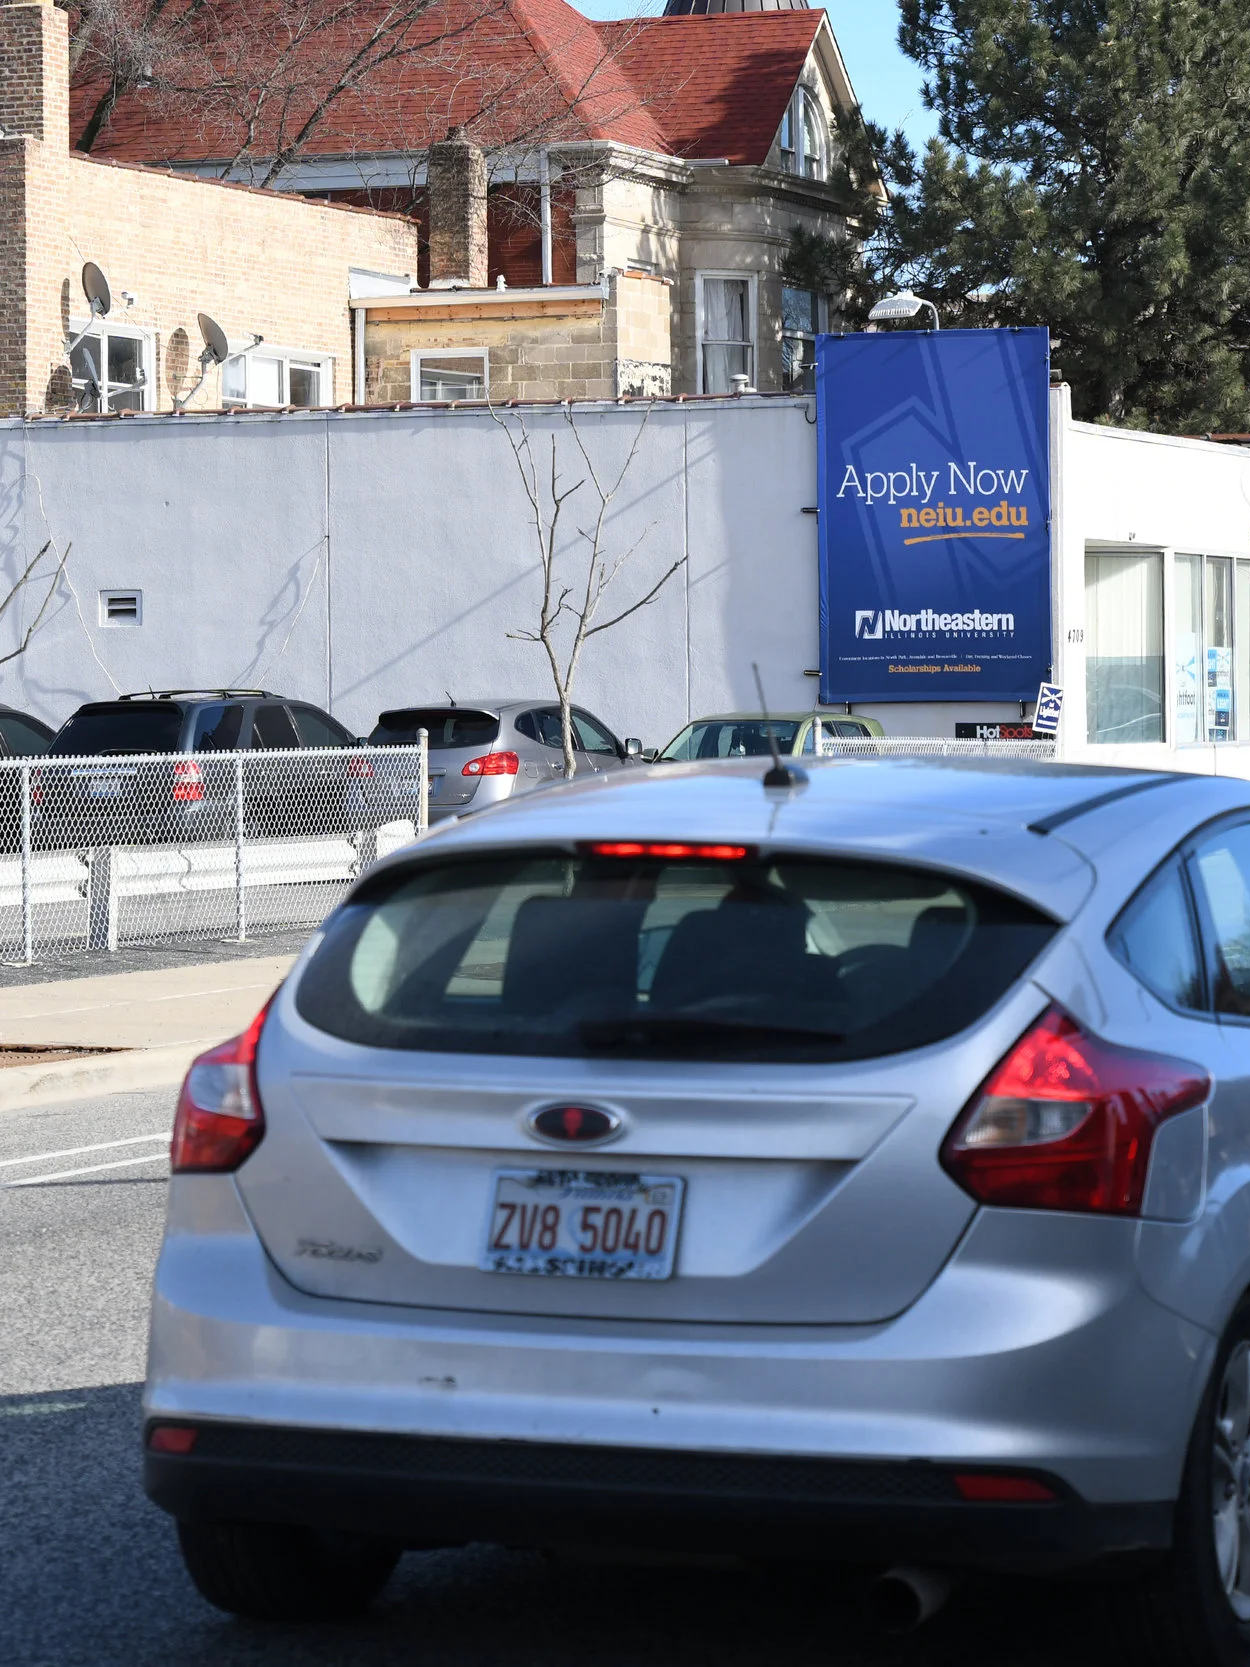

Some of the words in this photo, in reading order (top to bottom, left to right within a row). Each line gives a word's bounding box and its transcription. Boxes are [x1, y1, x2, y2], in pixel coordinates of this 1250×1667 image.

[836, 463, 939, 505] Apply
[948, 462, 1029, 495] Now
[900, 501, 1028, 527] neiu.edu
[884, 609, 1014, 631] Northeastern
[885, 631, 936, 639] ILLINOIS
[1067, 629, 1083, 642] 4709
[888, 664, 941, 673] Scholarships
[943, 664, 981, 673] Available
[493, 1203, 561, 1251] ZV8
[579, 1206, 667, 1256] 5040
